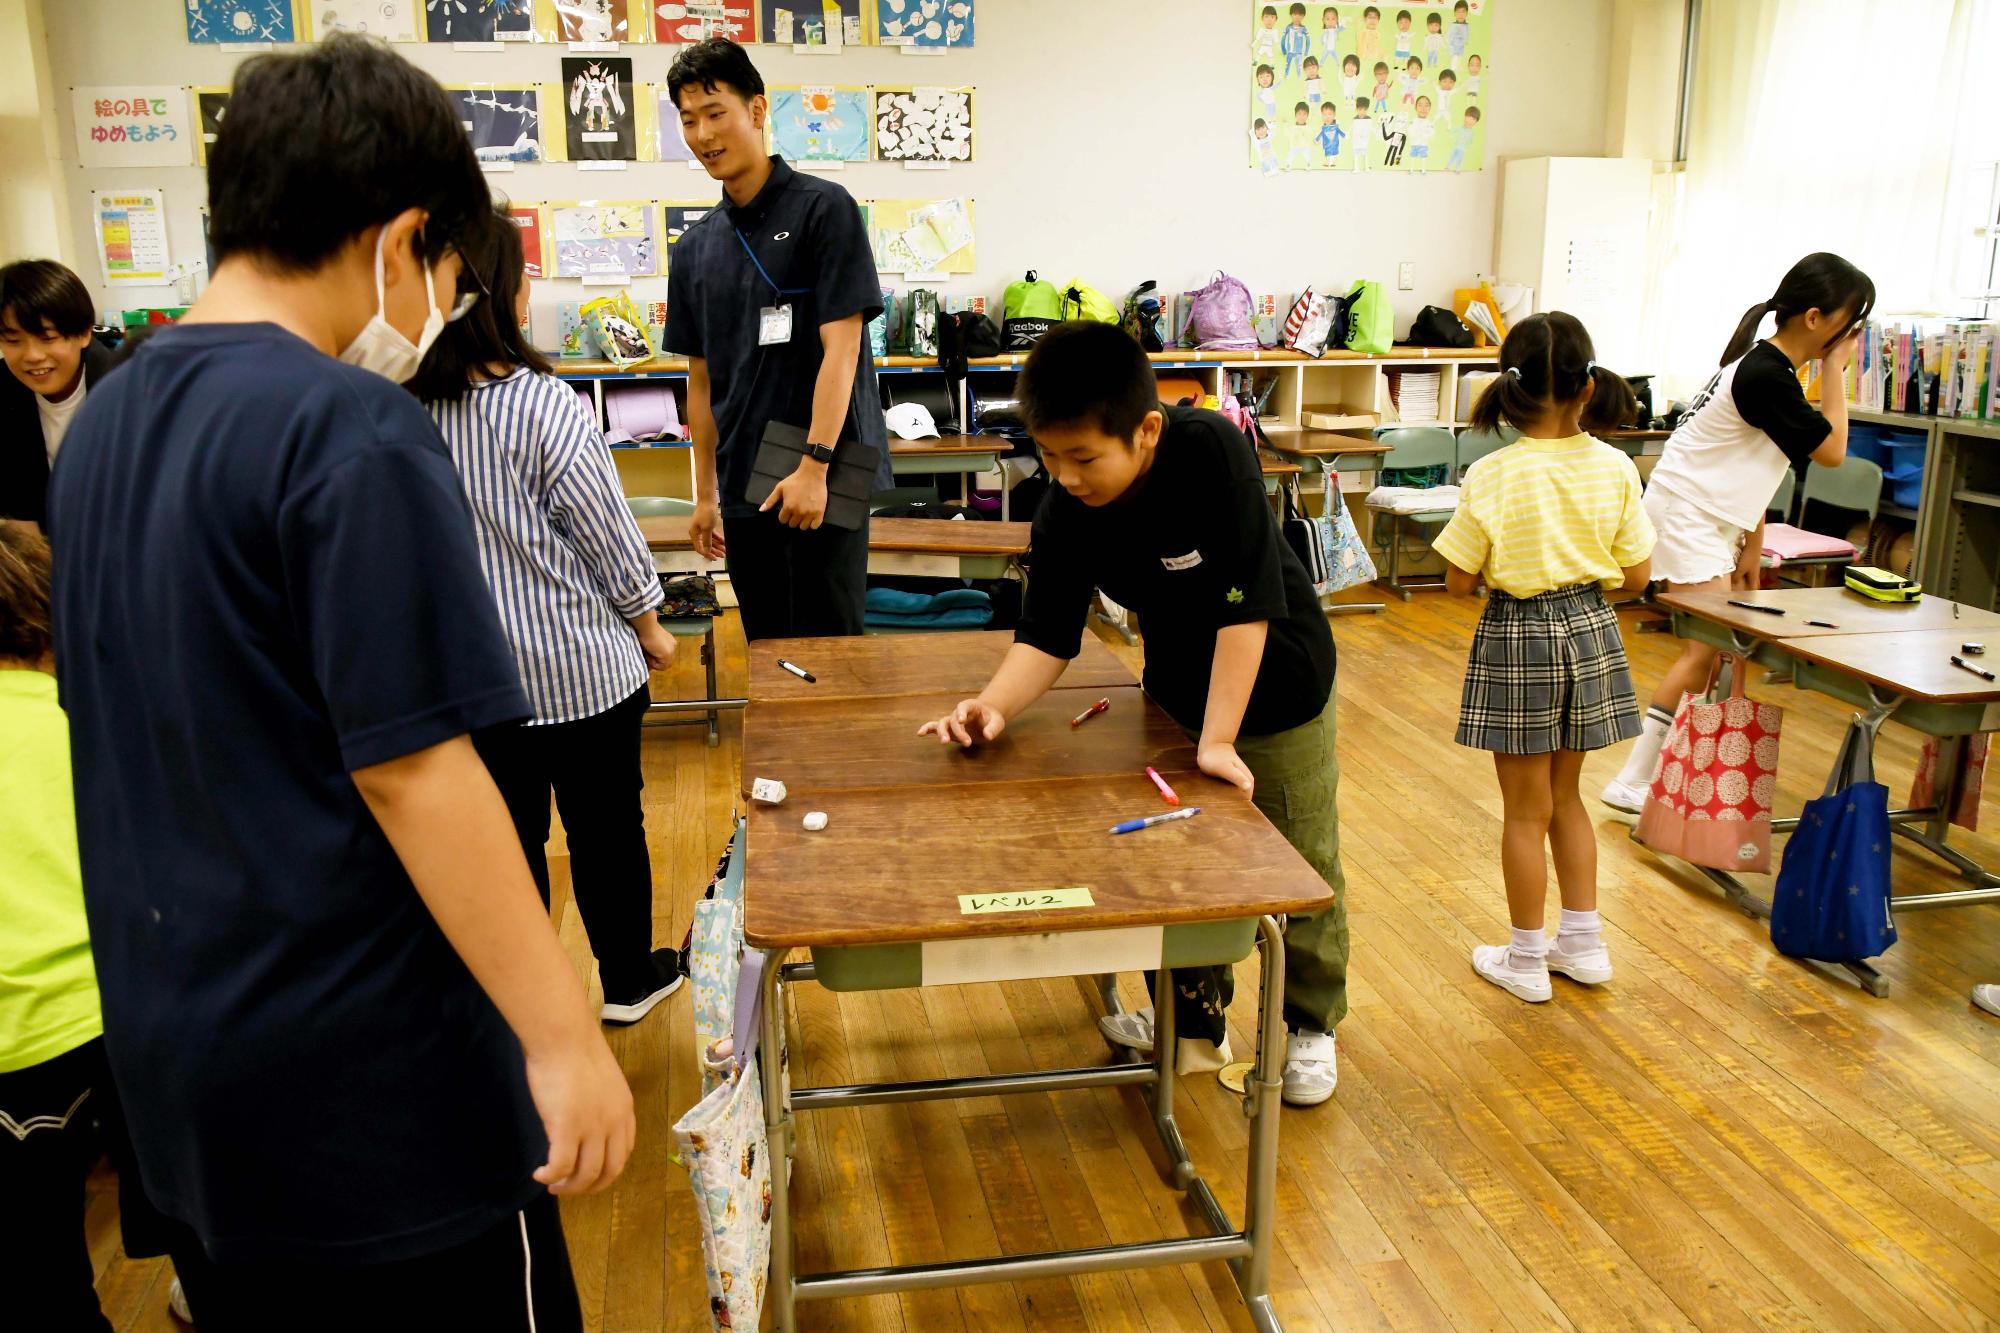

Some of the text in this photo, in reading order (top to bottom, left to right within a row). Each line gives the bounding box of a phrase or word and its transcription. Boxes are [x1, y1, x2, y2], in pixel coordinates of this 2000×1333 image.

[94, 98, 167, 117] 絵の具で
[91, 124, 177, 142] ゆめもよう
[1009, 322, 1049, 333] Reebok
[971, 895, 1063, 911] レベル2
